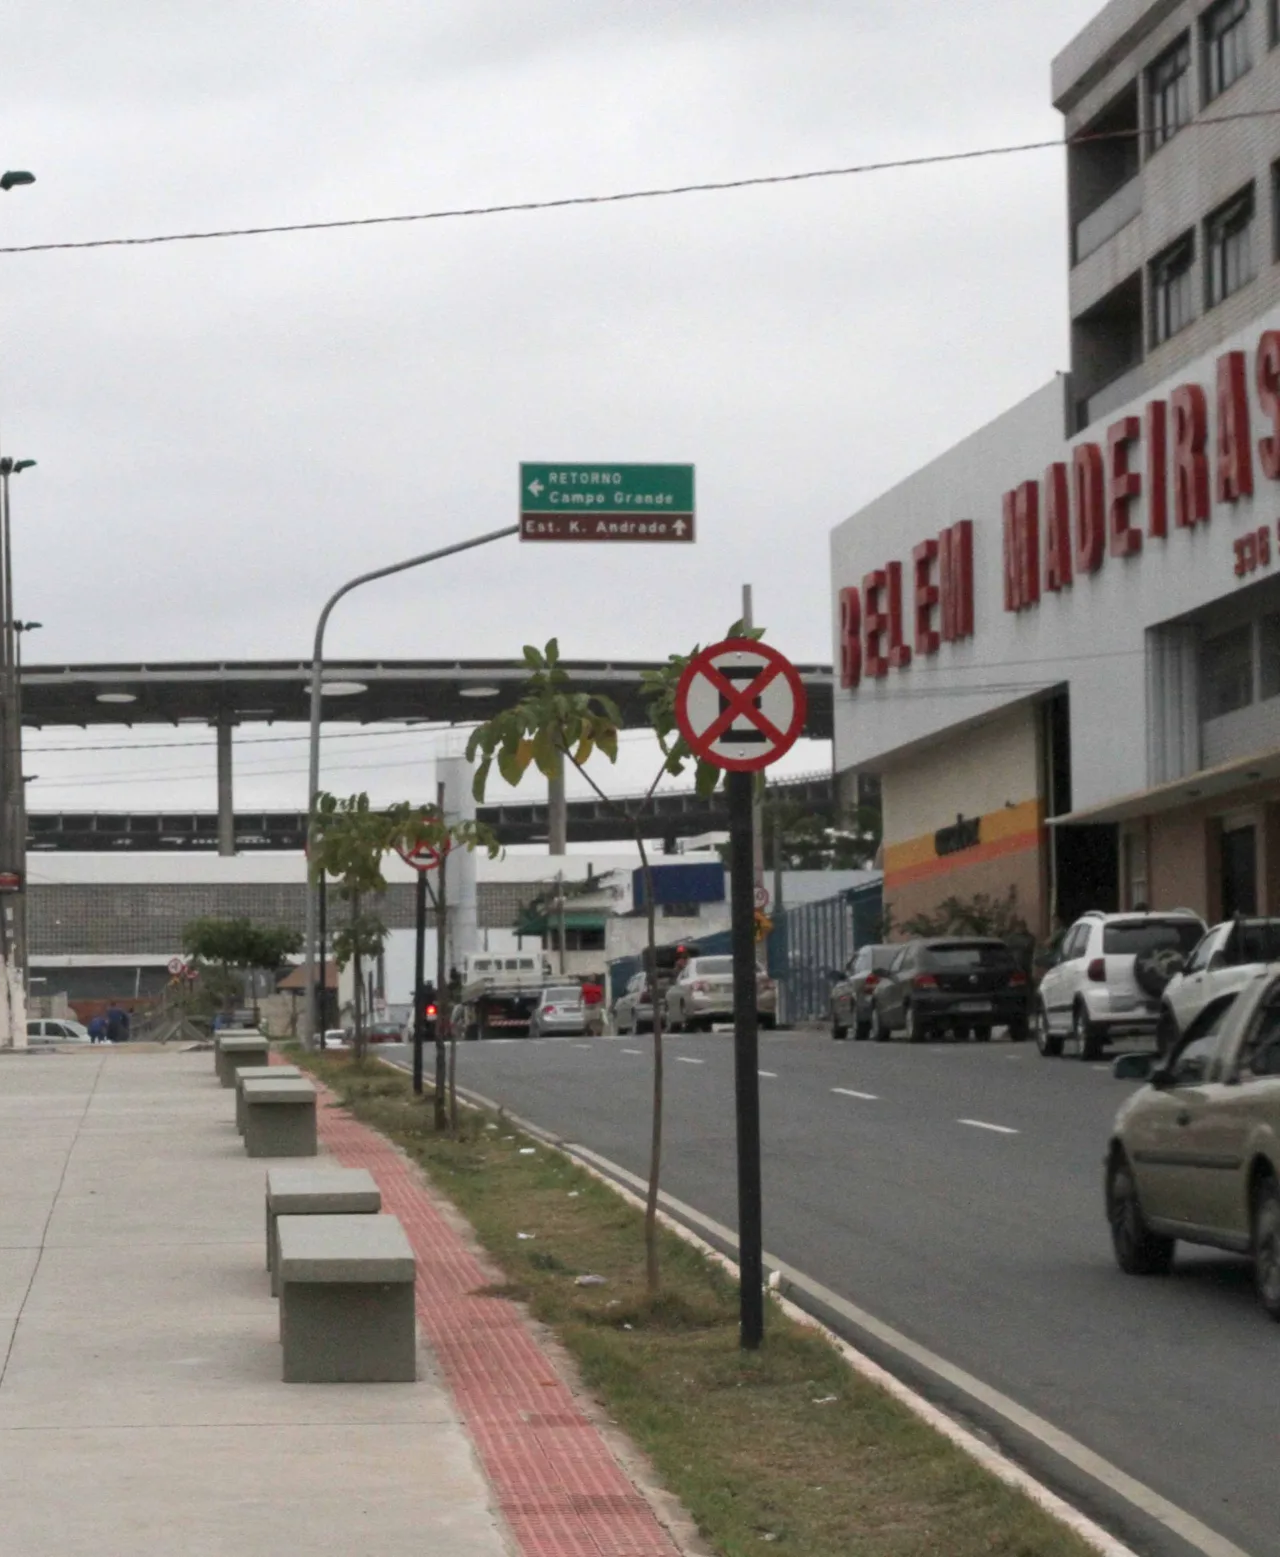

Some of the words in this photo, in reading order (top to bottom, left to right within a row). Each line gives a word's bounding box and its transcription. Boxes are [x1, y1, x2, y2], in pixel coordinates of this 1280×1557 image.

[549, 472, 622, 484] RETORNO
[549, 491, 605, 506] Campo
[614, 491, 673, 504] Grande
[839, 520, 974, 688] BELEM
[1002, 330, 1280, 613] MADEIRAS
[525, 520, 561, 533] Est.
[569, 521, 587, 533] K.
[596, 520, 667, 533] Andrade
